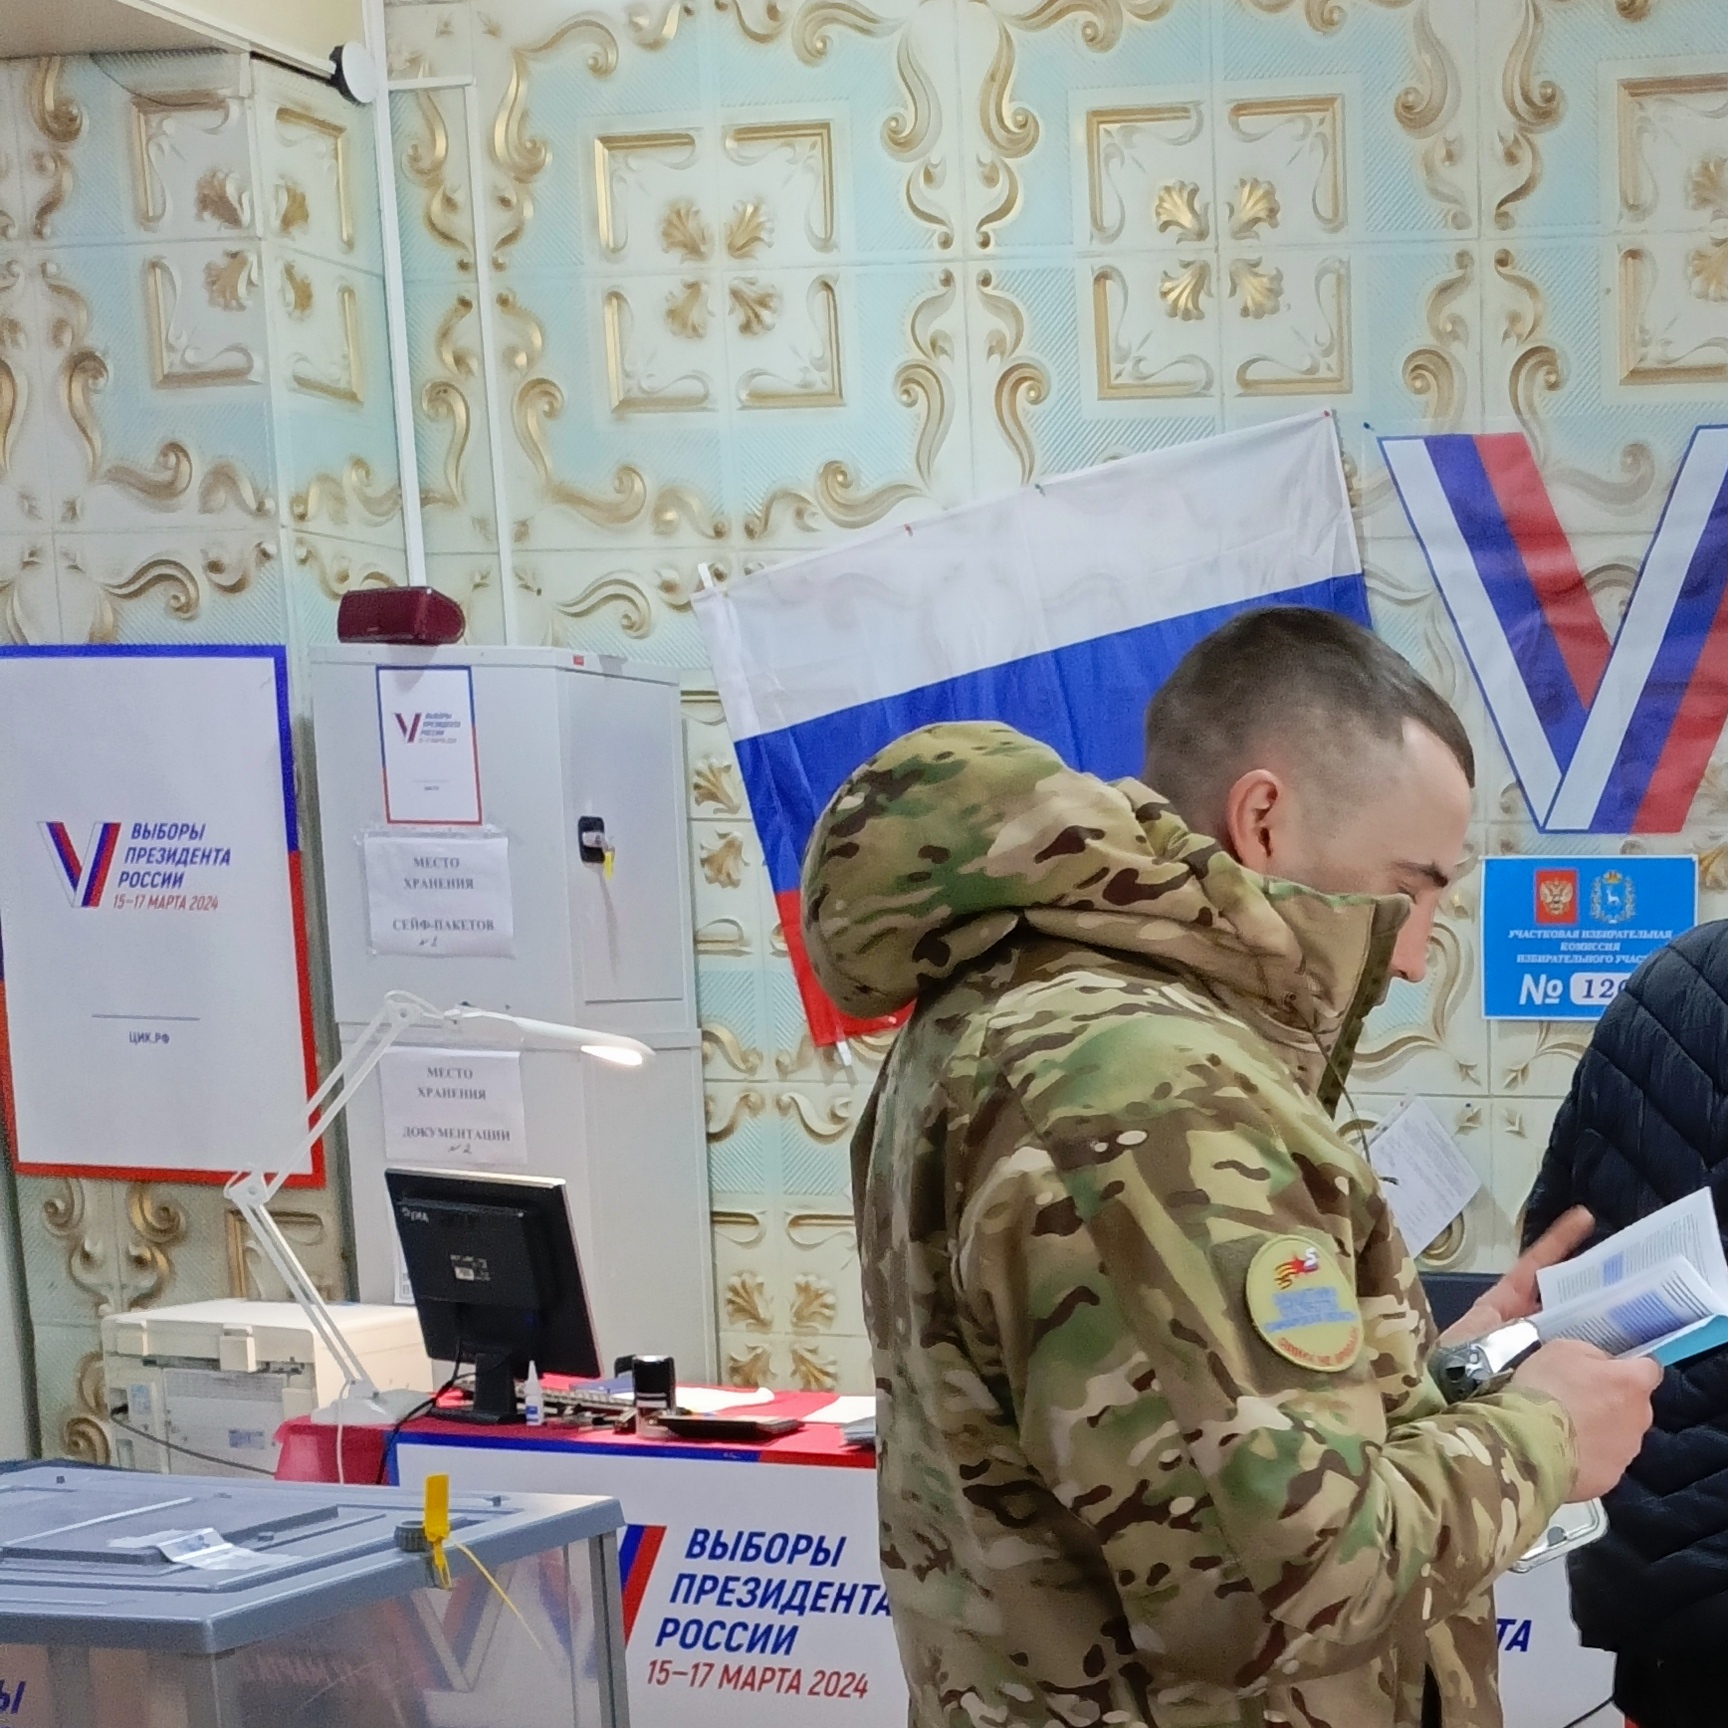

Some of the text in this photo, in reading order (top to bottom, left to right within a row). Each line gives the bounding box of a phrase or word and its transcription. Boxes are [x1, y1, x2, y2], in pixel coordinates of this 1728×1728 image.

[131, 822, 206, 841] ВЫБОРЫ
[124, 846, 231, 867] ПРЕЗИДЕНТА
[413, 857, 460, 868] МЕСТО
[117, 871, 186, 889] РОССИИ
[403, 878, 474, 890] ХРАНЕНИЯ
[147, 895, 187, 910] МАРТА
[189, 896, 219, 911] 2024
[1508, 929, 1579, 940] УЧАСТКОВАЯ
[1560, 942, 1621, 952] КОМИССИЯ
[427, 1067, 473, 1079] МЕСТО
[417, 1086, 487, 1100] ХРАНЕНИЯ
[402, 1126, 511, 1142] ДОКУМЕНТАЦИИ
[685, 1528, 847, 1568] ВЫБОРЫ
[669, 1572, 893, 1617] ПРЕЗИДЕНТА
[655, 1617, 799, 1656] РОССИИ
[717, 1664, 802, 1695] МАРТА
[807, 1669, 869, 1699] 2024
